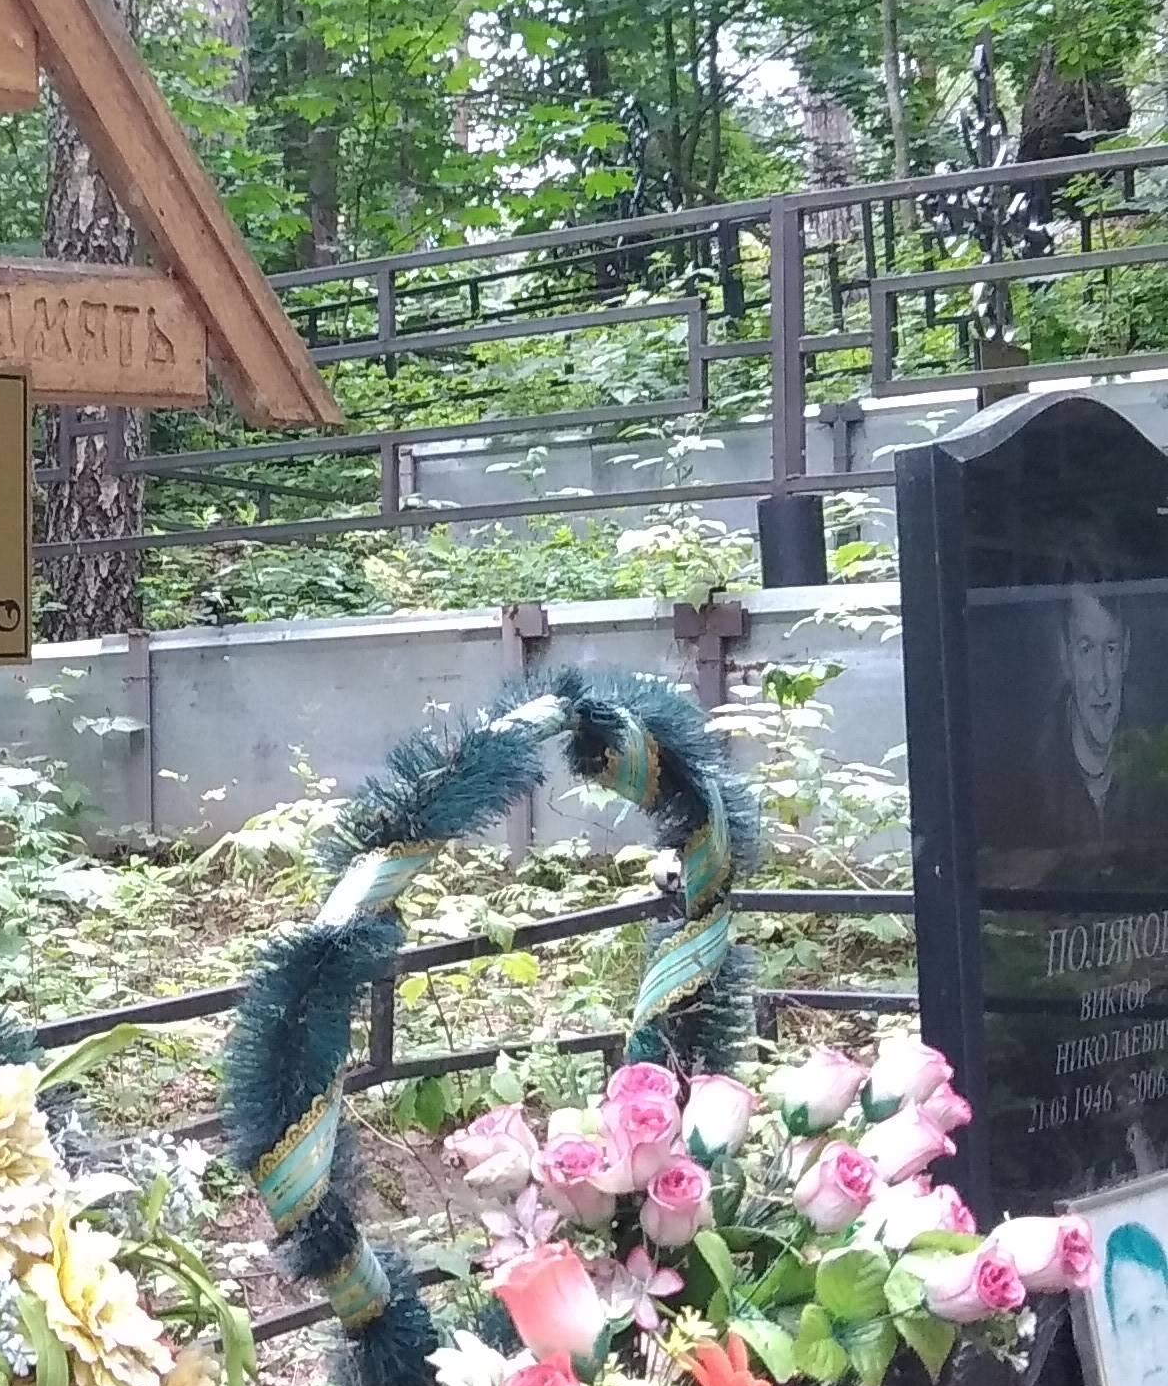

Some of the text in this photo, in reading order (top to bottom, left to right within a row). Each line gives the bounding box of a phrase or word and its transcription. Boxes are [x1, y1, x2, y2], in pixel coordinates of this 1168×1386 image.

[1079, 978, 1151, 1022] ВИКТОР
[1055, 1019, 1168, 1075] НИКОЛАЕВИ
[1027, 1080, 1112, 1133] 21.03.1946
